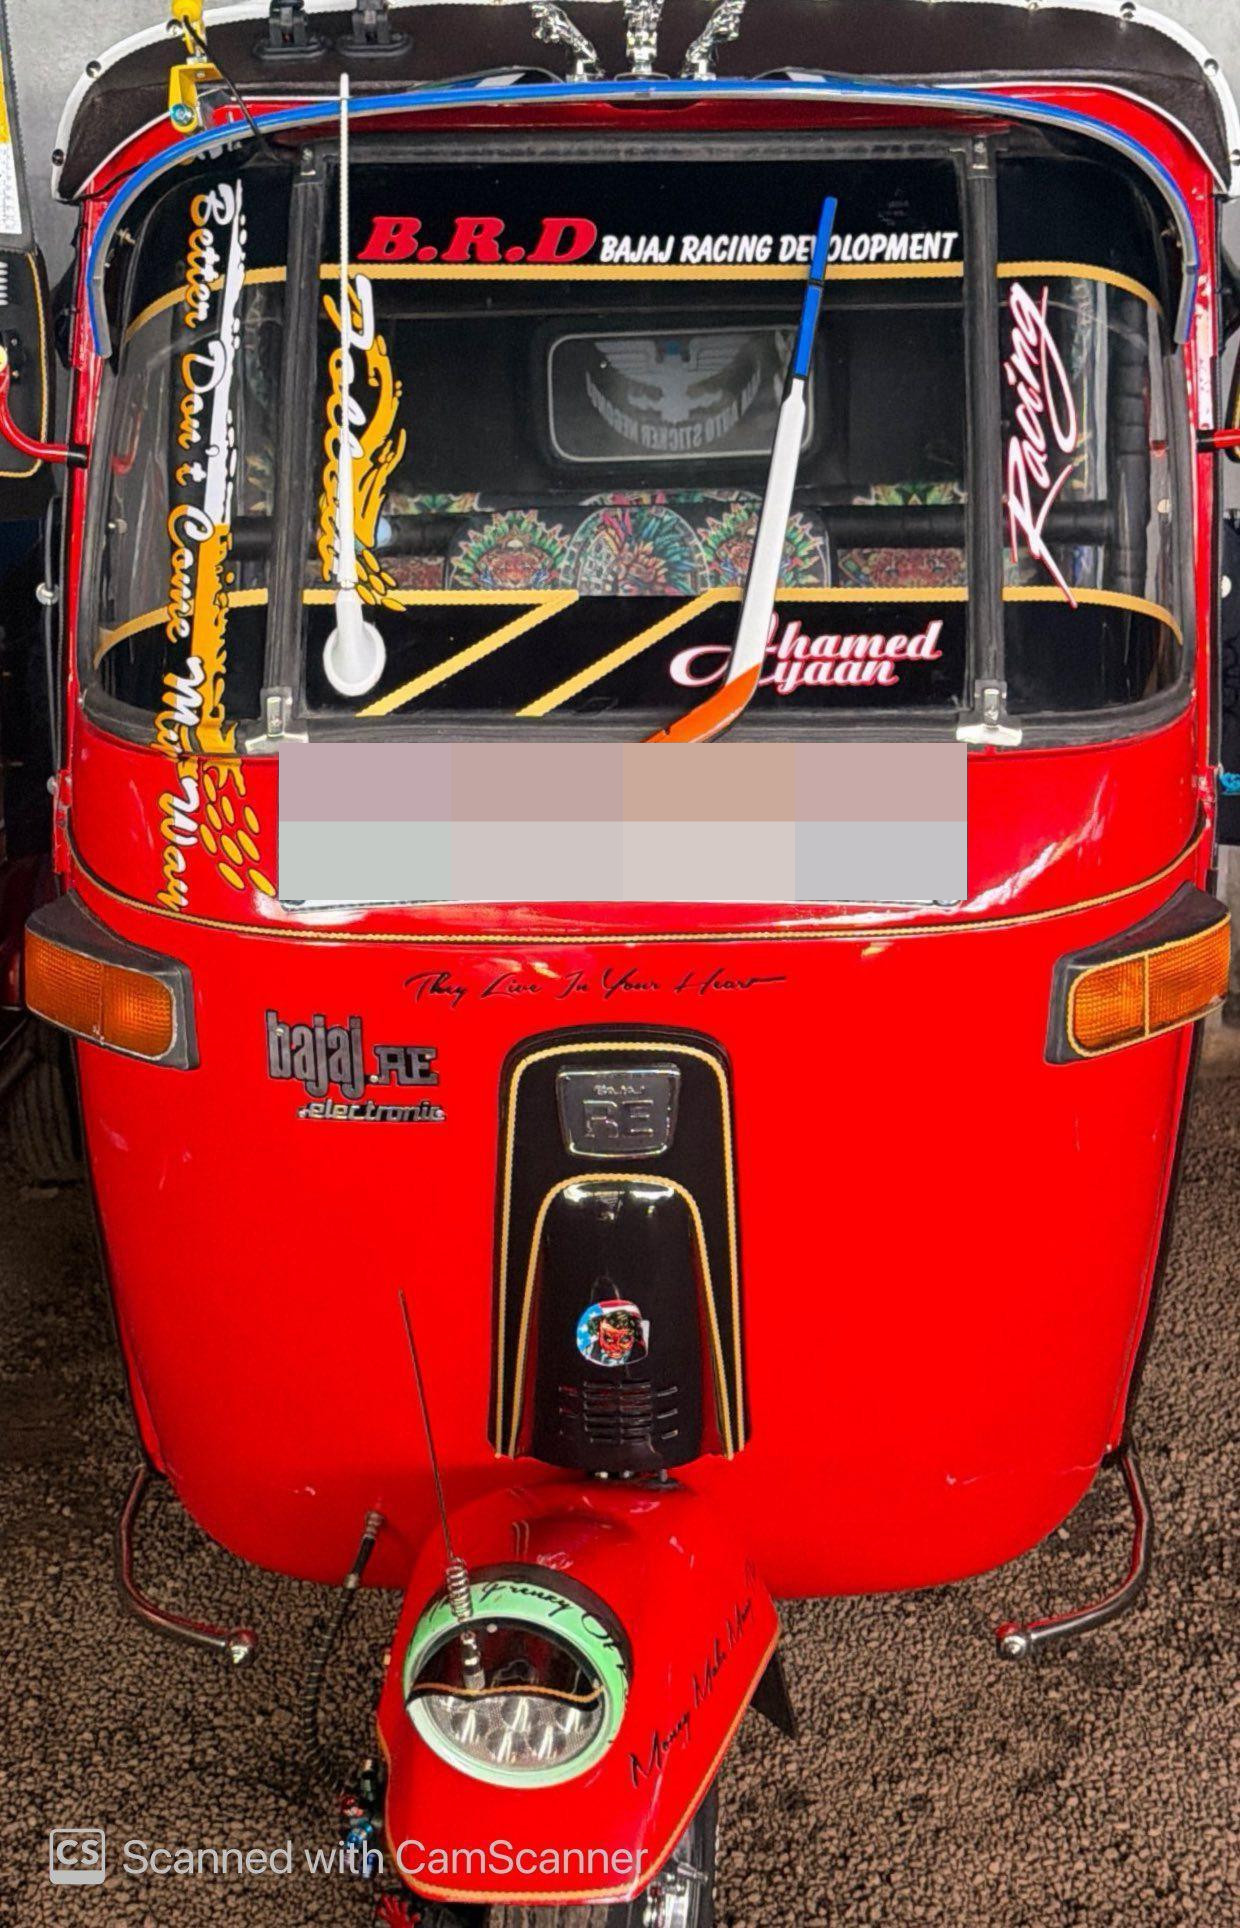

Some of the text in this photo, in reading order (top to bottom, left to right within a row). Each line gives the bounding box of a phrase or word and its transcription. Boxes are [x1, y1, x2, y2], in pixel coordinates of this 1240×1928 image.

[184, 182, 235, 329] Better
[357, 216, 598, 262] B.R.D
[600, 234, 675, 263] BAJAJ
[679, 233, 774, 263] RACING
[175, 340, 227, 487] Don't
[1003, 281, 1079, 609] Racing
[165, 503, 215, 644] Come
[156, 776, 200, 913] Way
[403, 966, 788, 1009] They Live In Your Heart
[266, 1009, 365, 1100] bajaj
[297, 1098, 447, 1123] electronic
[583, 1099, 654, 1138] RE
